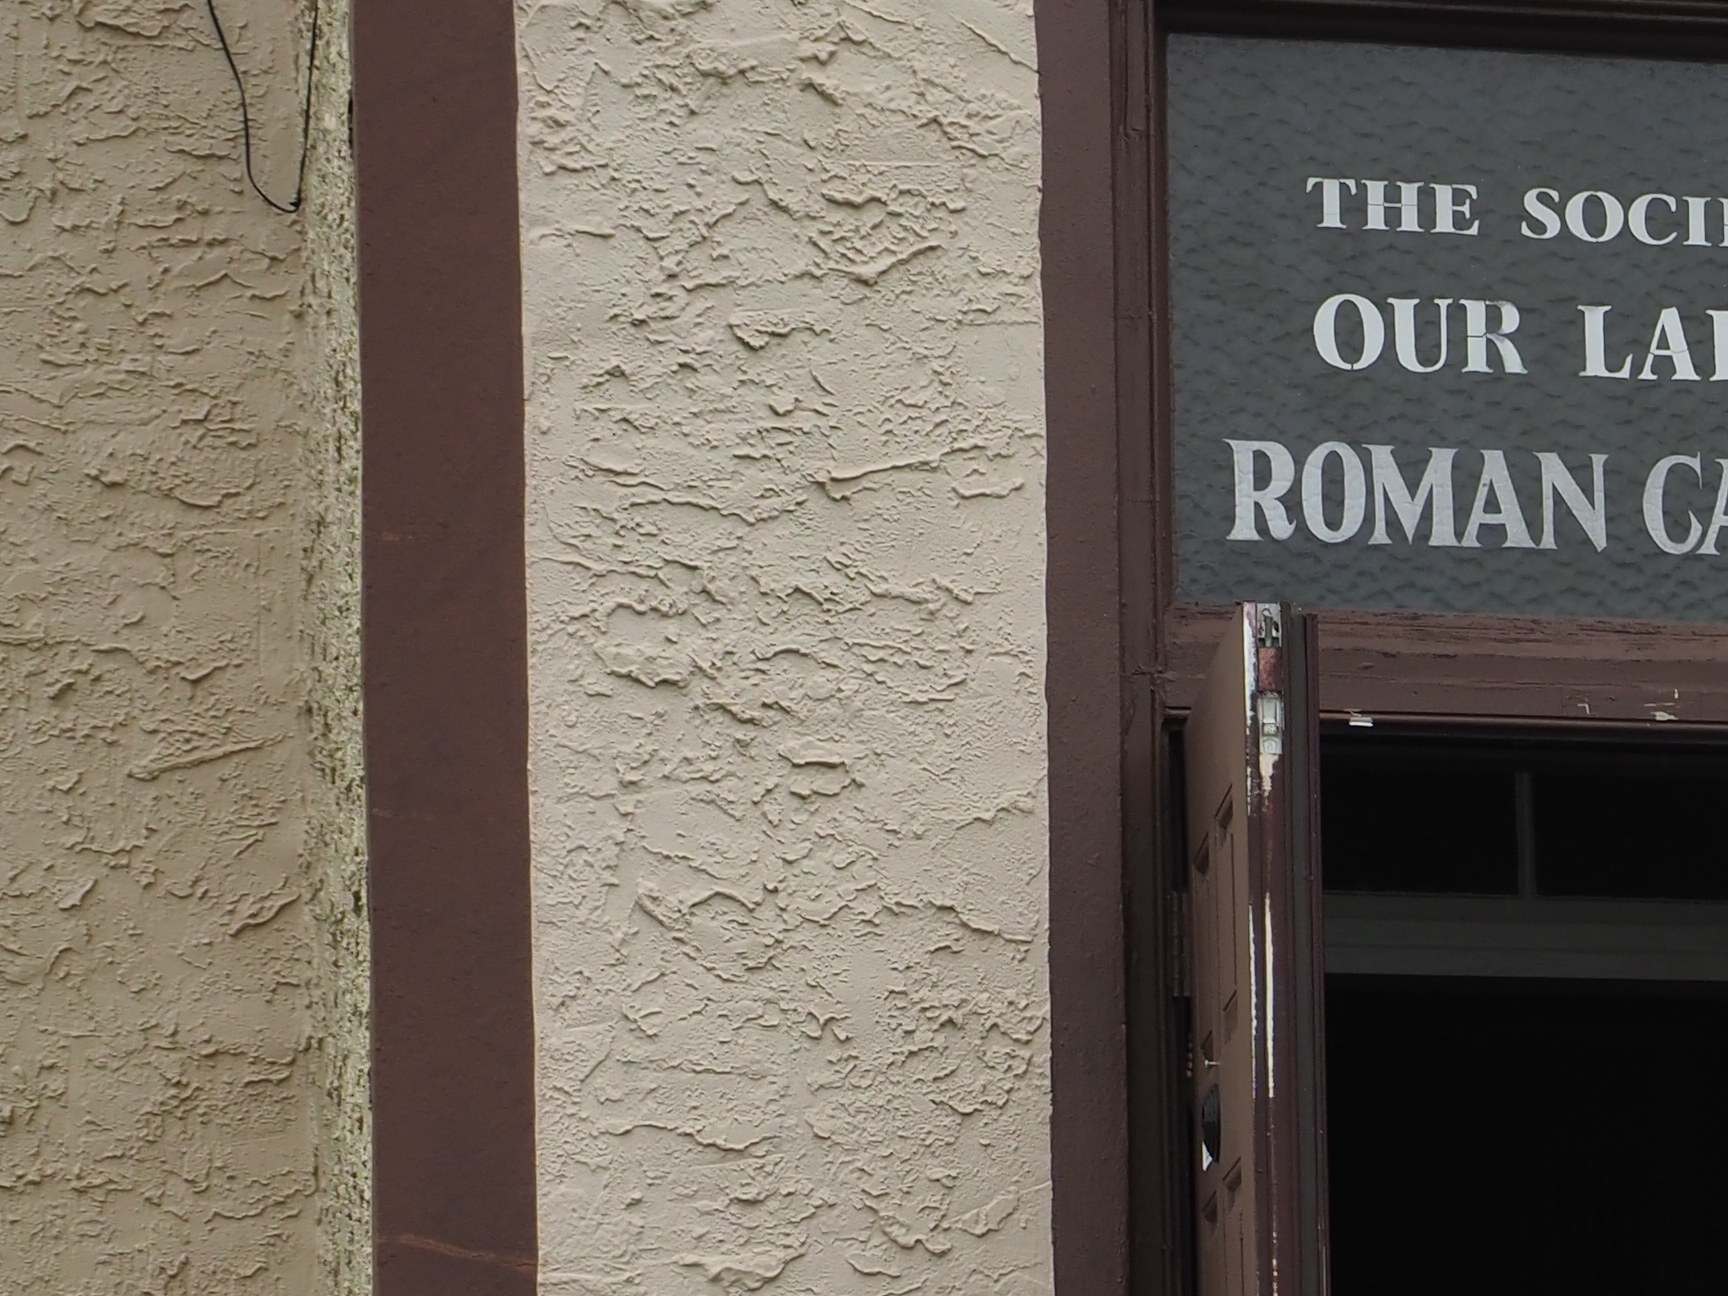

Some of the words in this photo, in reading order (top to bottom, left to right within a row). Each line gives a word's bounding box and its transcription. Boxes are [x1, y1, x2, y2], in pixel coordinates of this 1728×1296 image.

[1305, 177, 1480, 236] THE
[1312, 293, 1529, 374] OUR
[1222, 438, 1609, 553] ROMAN
